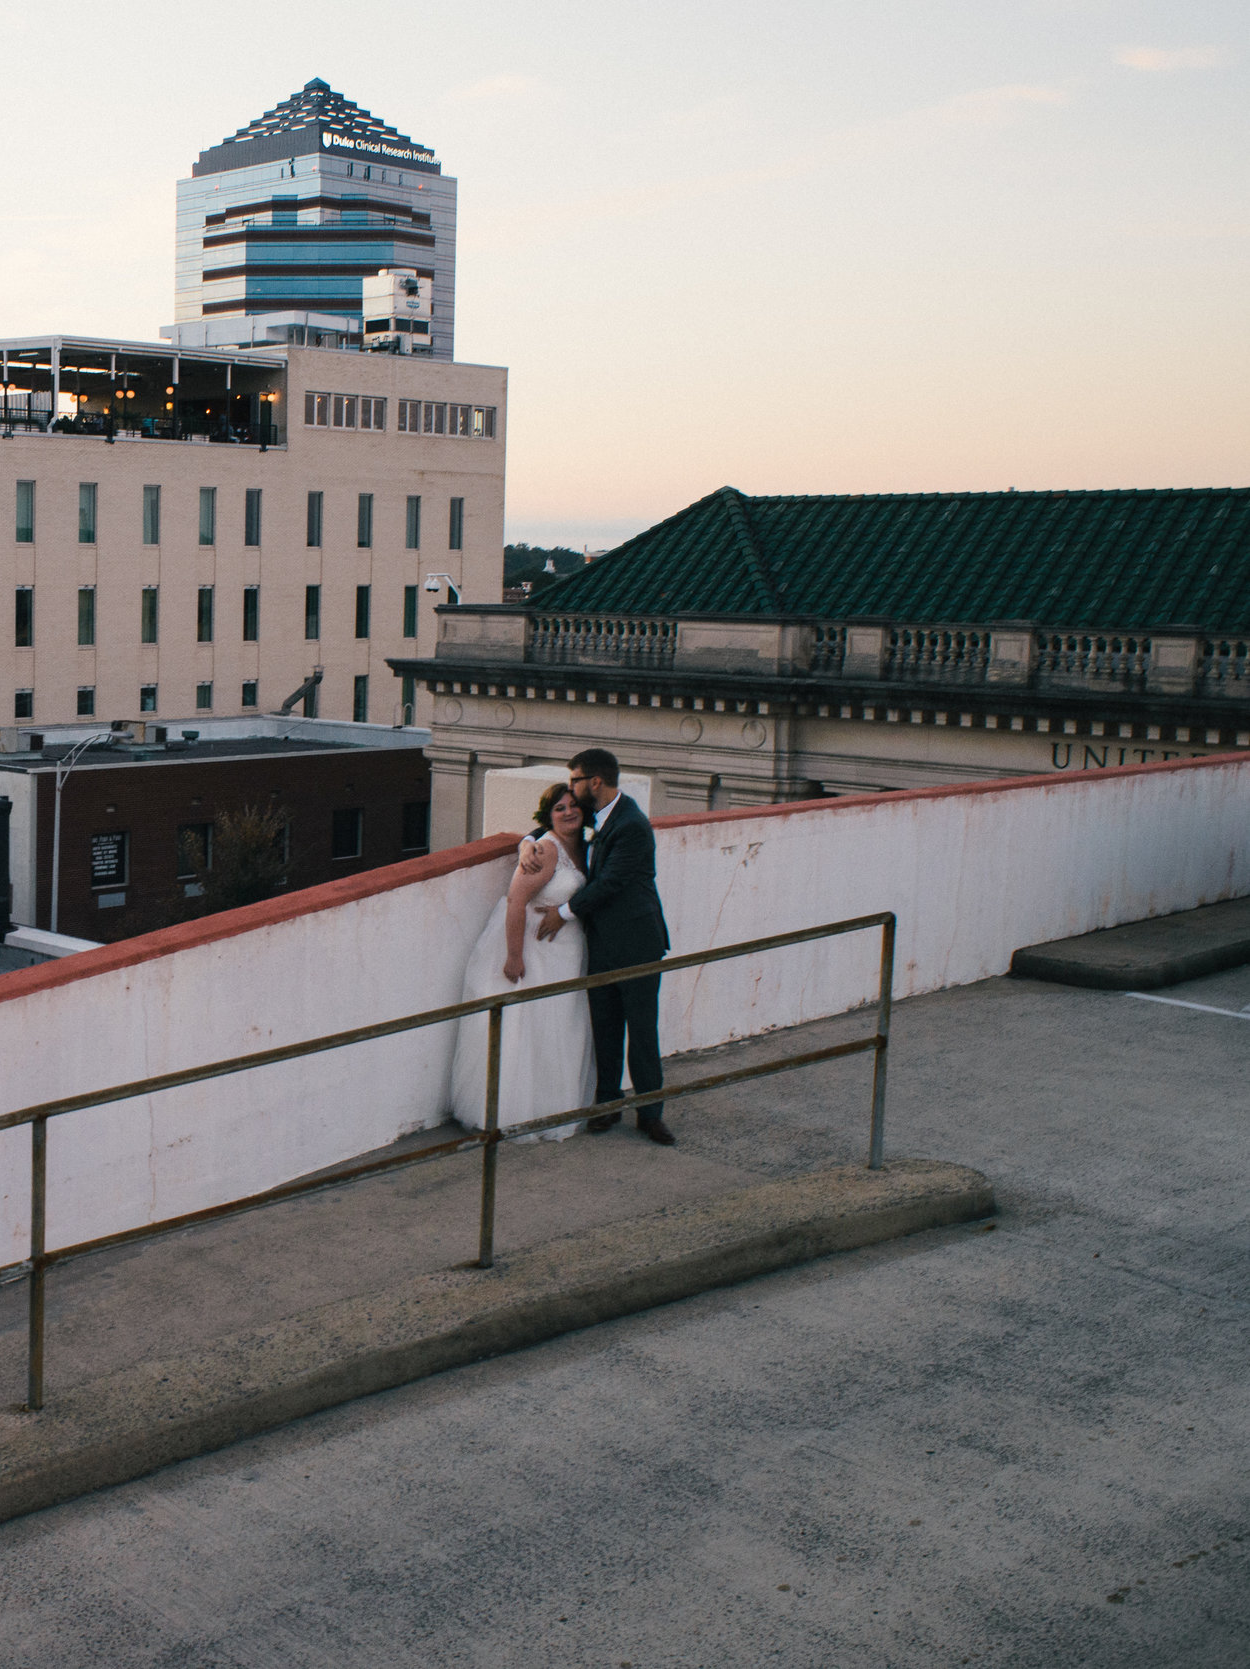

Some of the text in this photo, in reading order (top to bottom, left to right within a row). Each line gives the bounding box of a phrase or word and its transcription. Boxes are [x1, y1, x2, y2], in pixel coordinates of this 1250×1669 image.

[332, 134, 354, 149] Duke
[355, 139, 381, 154] Clinical
[381, 144, 412, 160] Research
